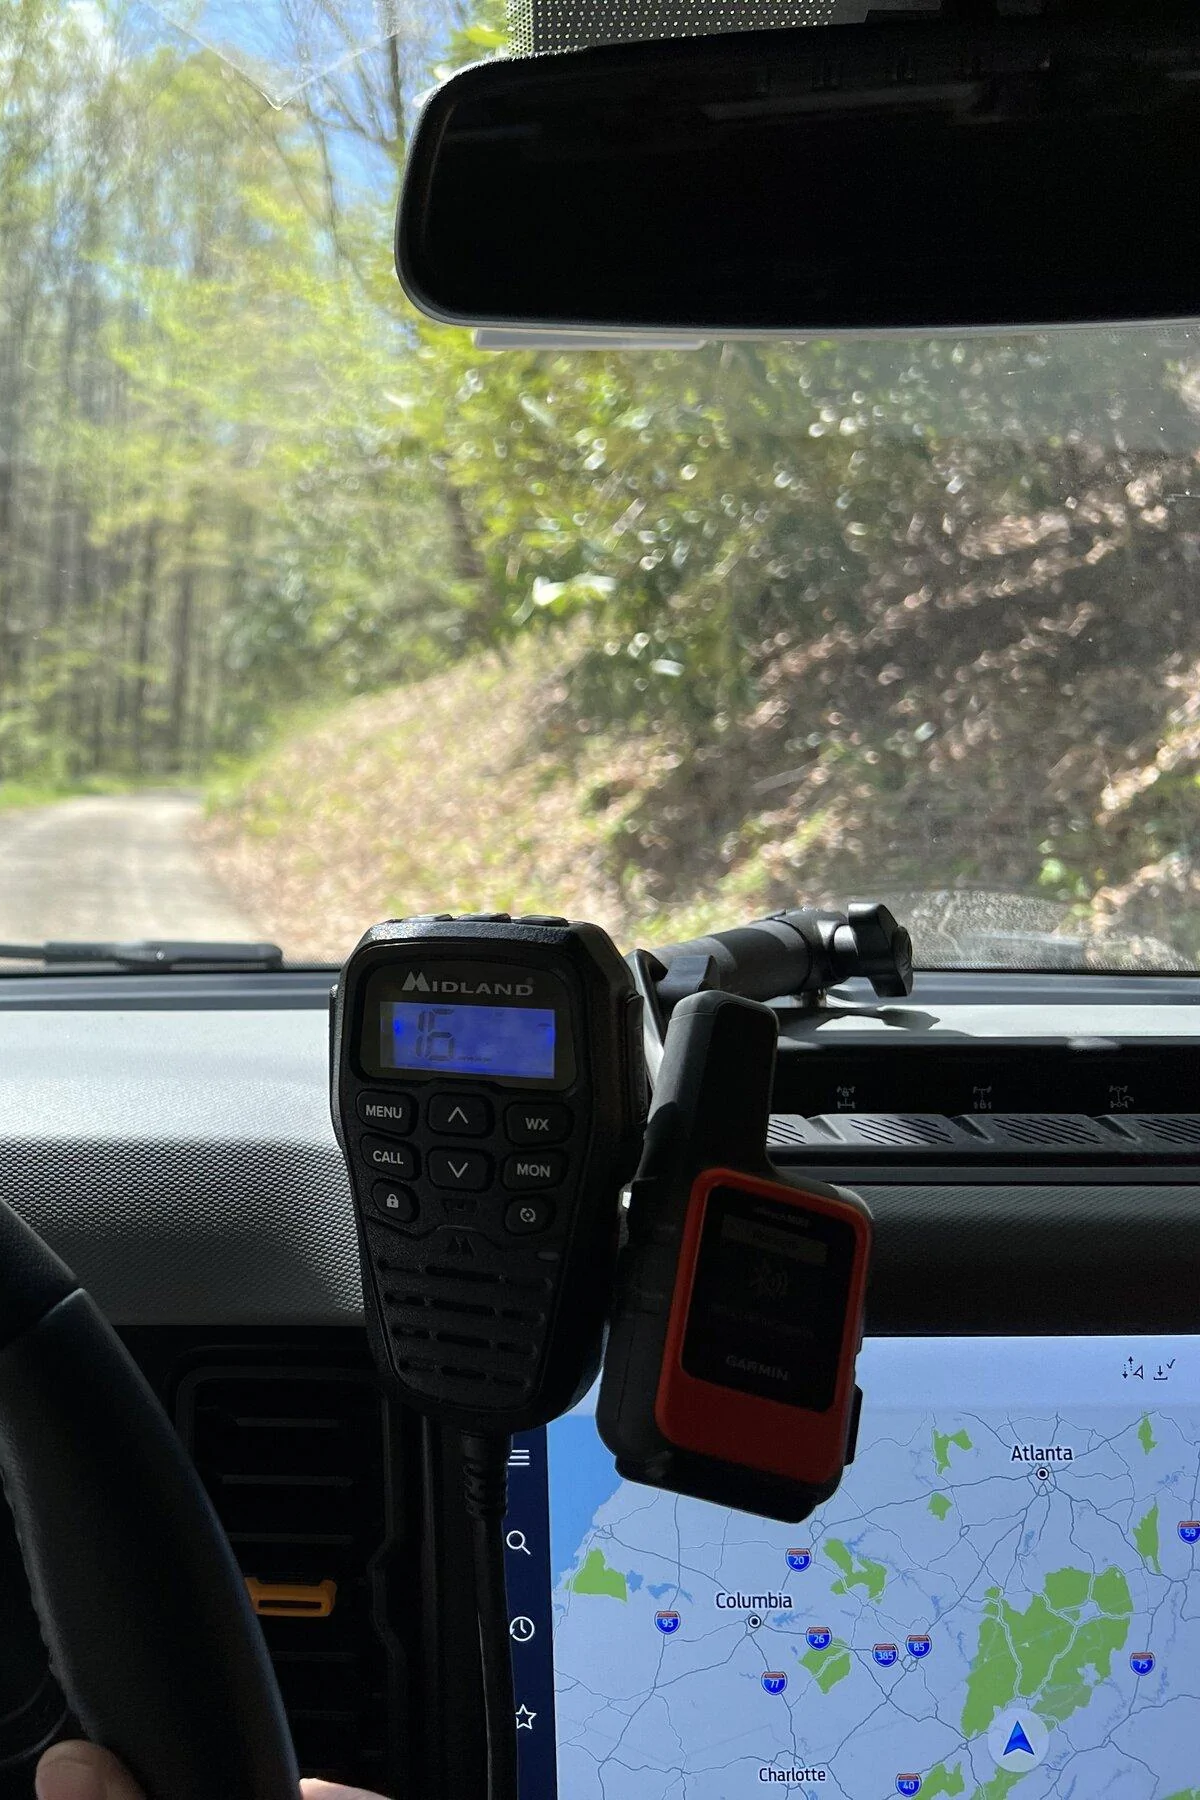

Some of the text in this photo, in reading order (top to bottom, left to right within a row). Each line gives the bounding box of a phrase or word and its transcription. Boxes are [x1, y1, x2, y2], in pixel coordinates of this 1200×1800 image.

[402, 971, 534, 997] MIDLAND
[365, 1104, 402, 1119] MENU
[525, 1117, 549, 1132] WX
[372, 1150, 404, 1165] CALL
[516, 1163, 551, 1178] MON
[725, 1354, 789, 1381] GARMIN
[1011, 1445, 1073, 1461] Atlanta
[1185, 1527, 1196, 1538] 59
[793, 1556, 805, 1566] 20
[716, 1592, 792, 1608] Columbia
[661, 1618, 674, 1628] 95
[813, 1634, 825, 1645] 26
[913, 1642, 925, 1652] 85
[877, 1650, 894, 1661] 385
[1138, 1659, 1149, 1669] 75
[769, 1679, 780, 1689] 77
[759, 1767, 826, 1783] Charlotte
[903, 1780, 915, 1791] 40
